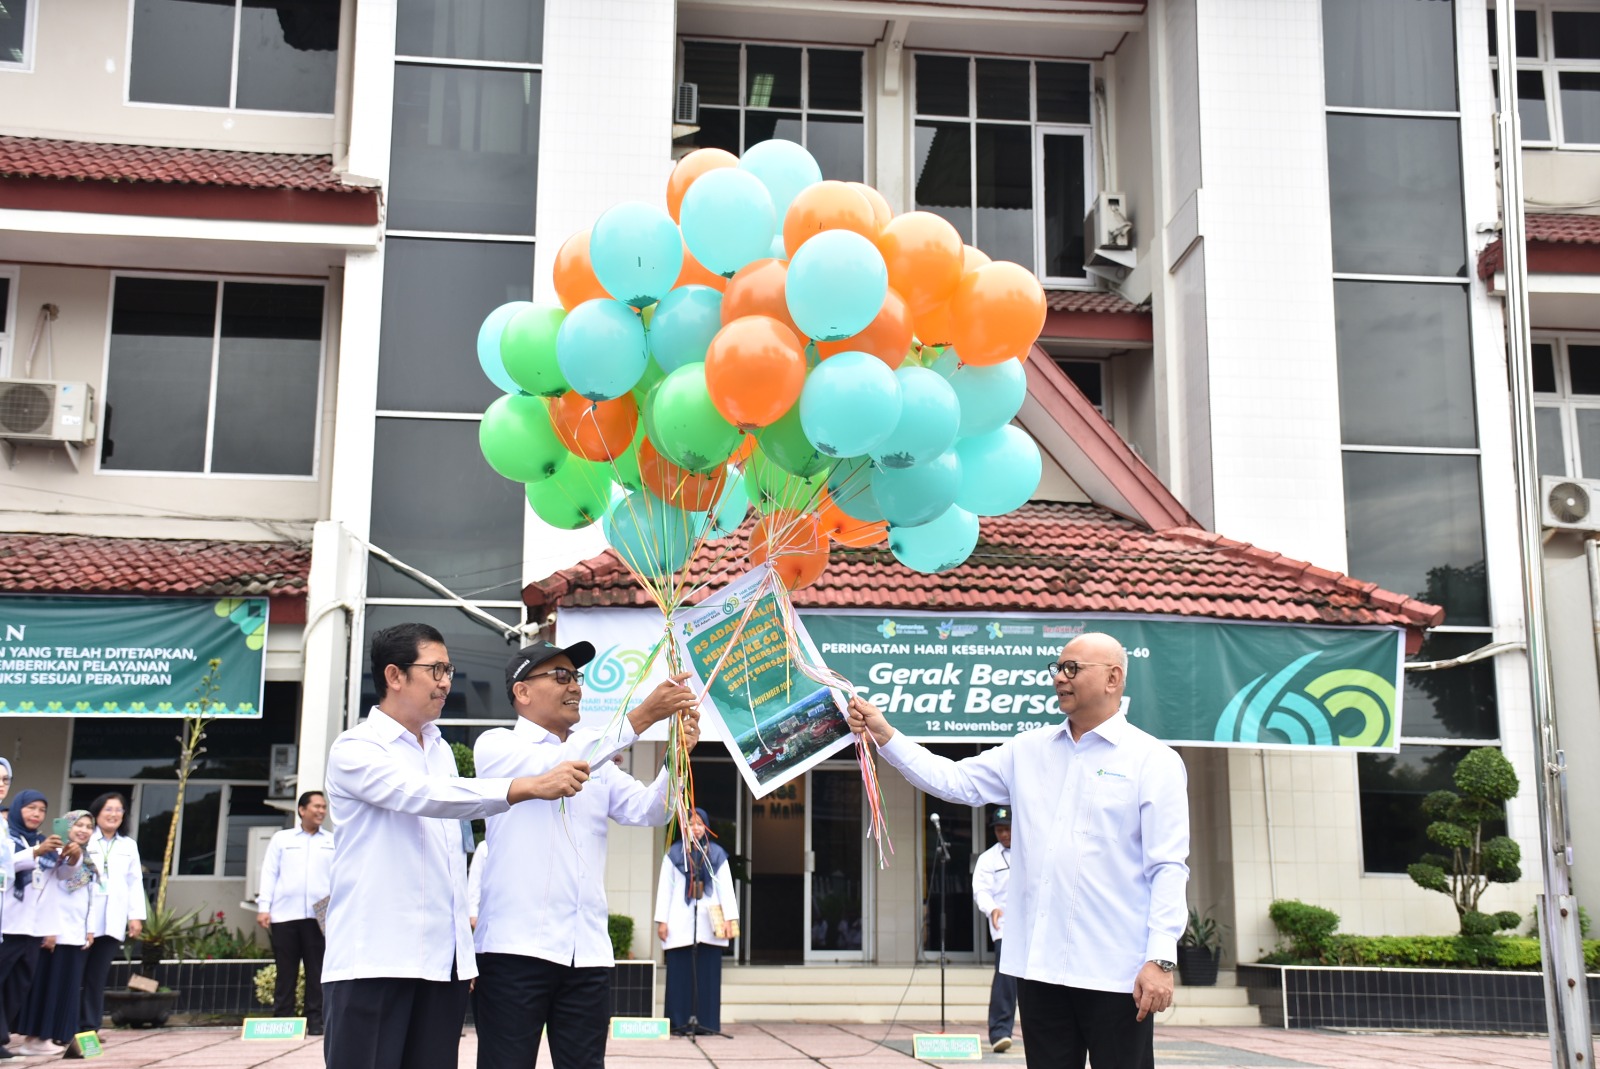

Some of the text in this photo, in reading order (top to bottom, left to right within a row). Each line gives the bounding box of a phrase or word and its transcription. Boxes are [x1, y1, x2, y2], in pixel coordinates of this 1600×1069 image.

[0, 624, 26, 641] N
[694, 639, 709, 655] RS
[748, 602, 776, 621] ALIK
[745, 639, 762, 655] KE
[763, 631, 779, 645] 60
[822, 643, 910, 654] PERINGATAN
[914, 644, 948, 655] HARI
[952, 645, 1032, 656] KESEHATAN
[1123, 647, 1149, 658] -60
[9, 646, 52, 658] YANG
[55, 647, 102, 659] TELAH
[105, 647, 198, 661] DITETAPKAN,
[0, 660, 169, 672] MBERIKAN PELAYANAN
[869, 662, 1054, 686] Gerak Bersa
[30, 673, 81, 684] SESUAI
[85, 673, 171, 685] PERATURAN
[755, 686, 780, 706] NOVEMBER
[780, 679, 793, 691] 204
[964, 687, 1131, 715] Bersa
[926, 721, 940, 731] 12
[944, 720, 1013, 731] November
